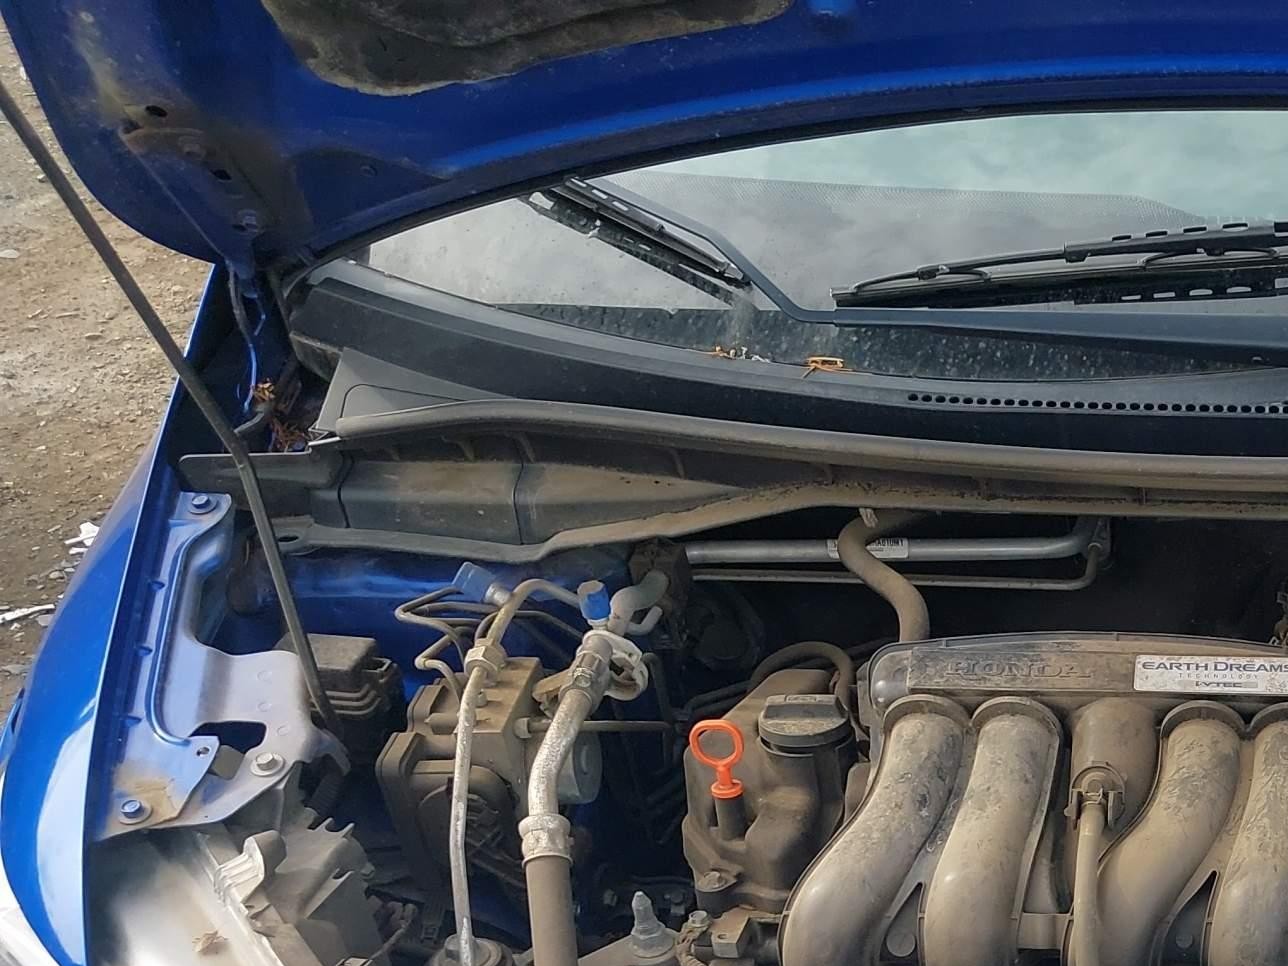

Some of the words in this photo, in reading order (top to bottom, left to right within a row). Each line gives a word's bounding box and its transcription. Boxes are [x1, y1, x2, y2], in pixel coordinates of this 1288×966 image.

[944, 658, 1092, 680] HONDA
[1141, 661, 1208, 671] EARTH
[1178, 672, 1258, 680] TECHNOLOGY
